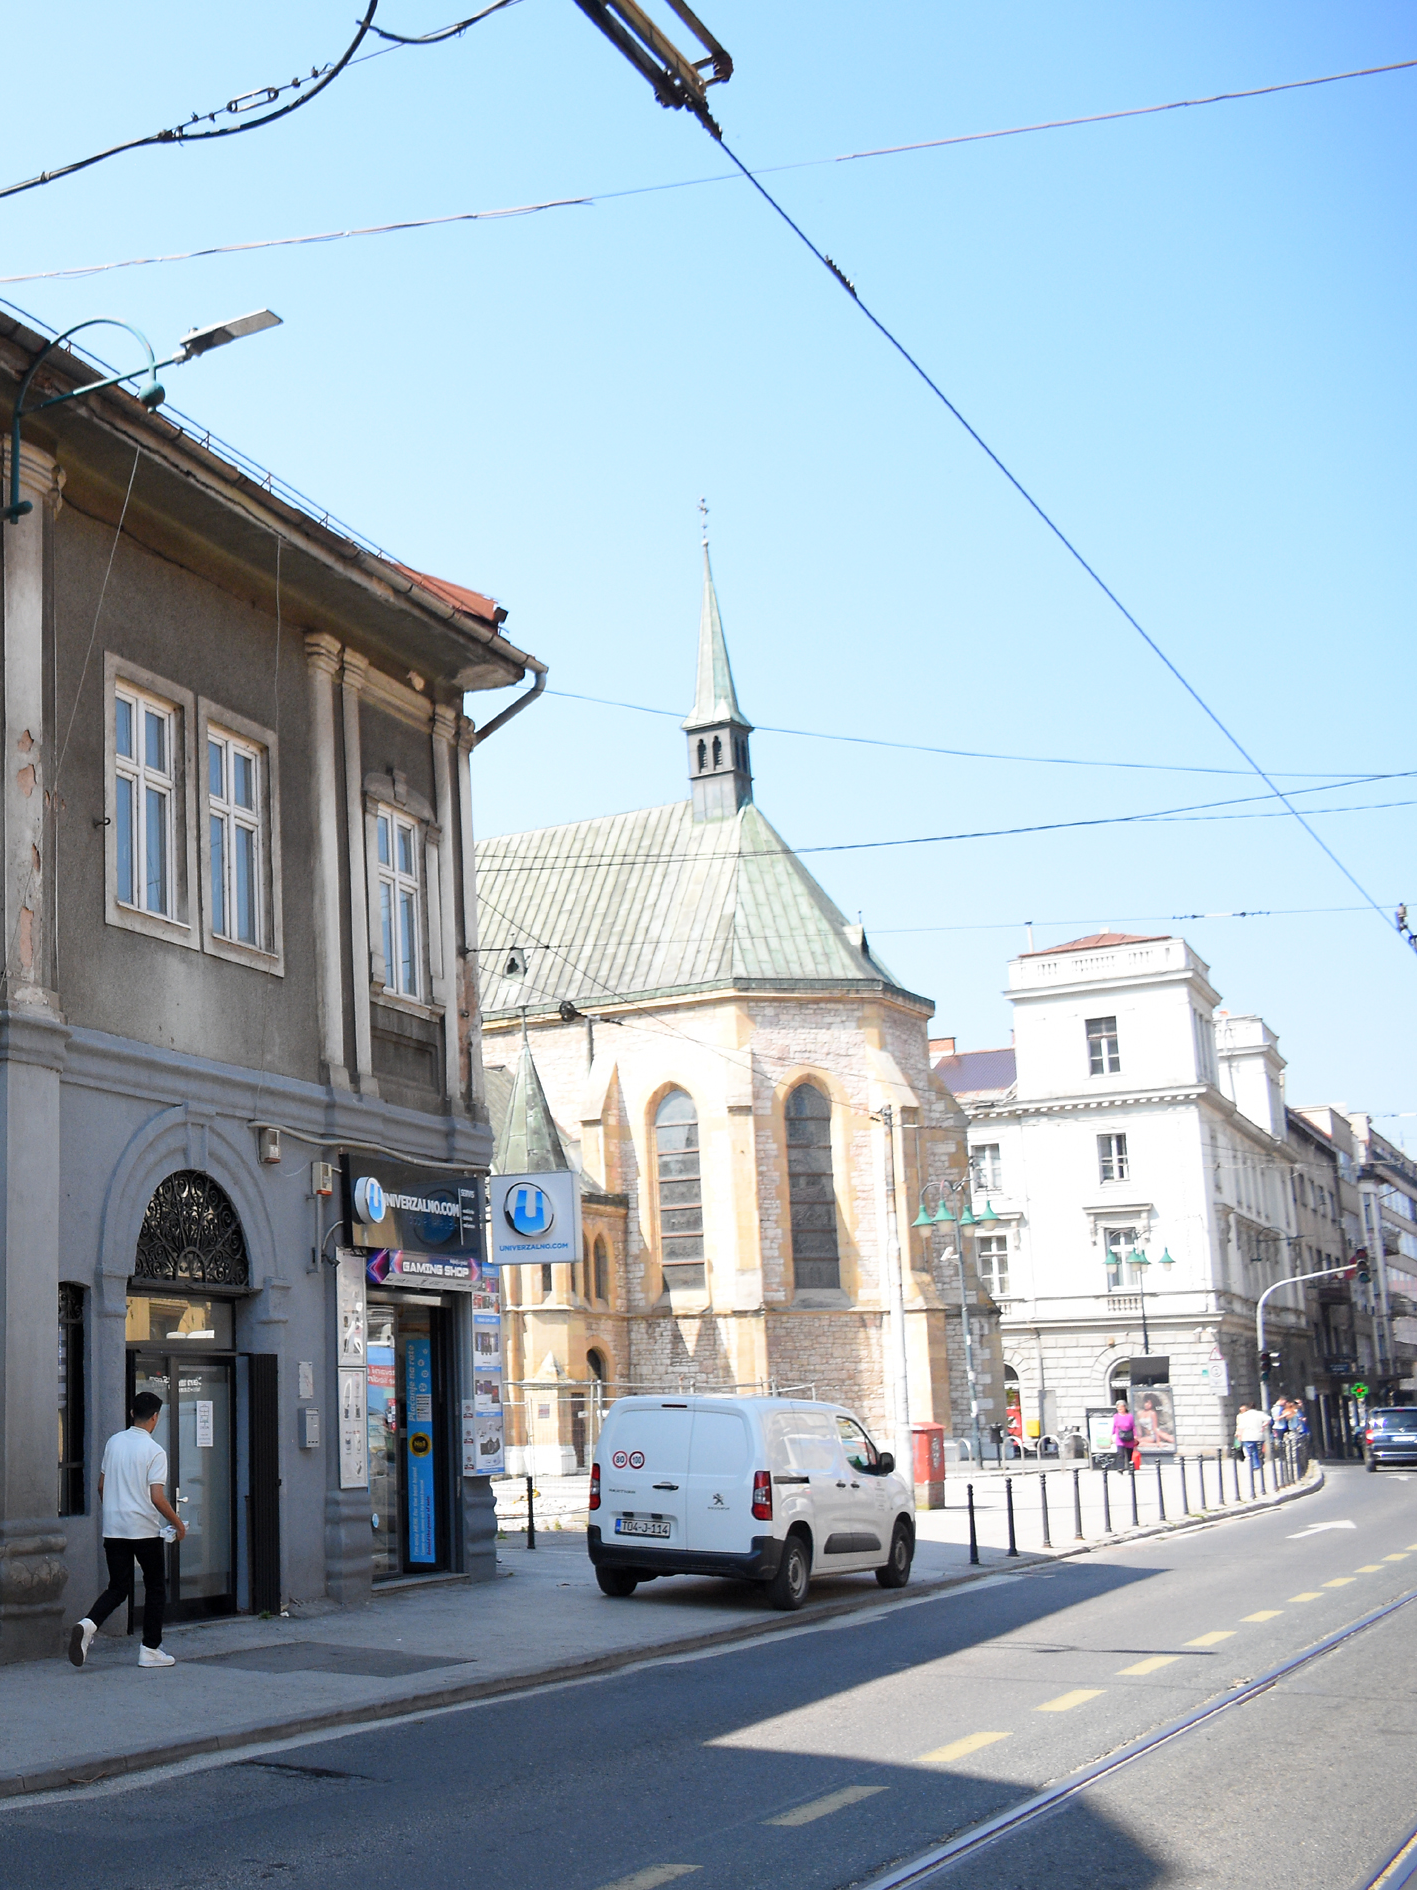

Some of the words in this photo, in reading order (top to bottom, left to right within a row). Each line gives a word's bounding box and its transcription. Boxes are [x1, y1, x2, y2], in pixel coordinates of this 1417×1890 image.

[499, 1243, 568, 1251] UNIVERZALNO.COM
[402, 1261, 443, 1275] GAMING
[444, 1265, 470, 1278] SHOP
[616, 1455, 625, 1463] 80
[632, 1456, 642, 1464] 100
